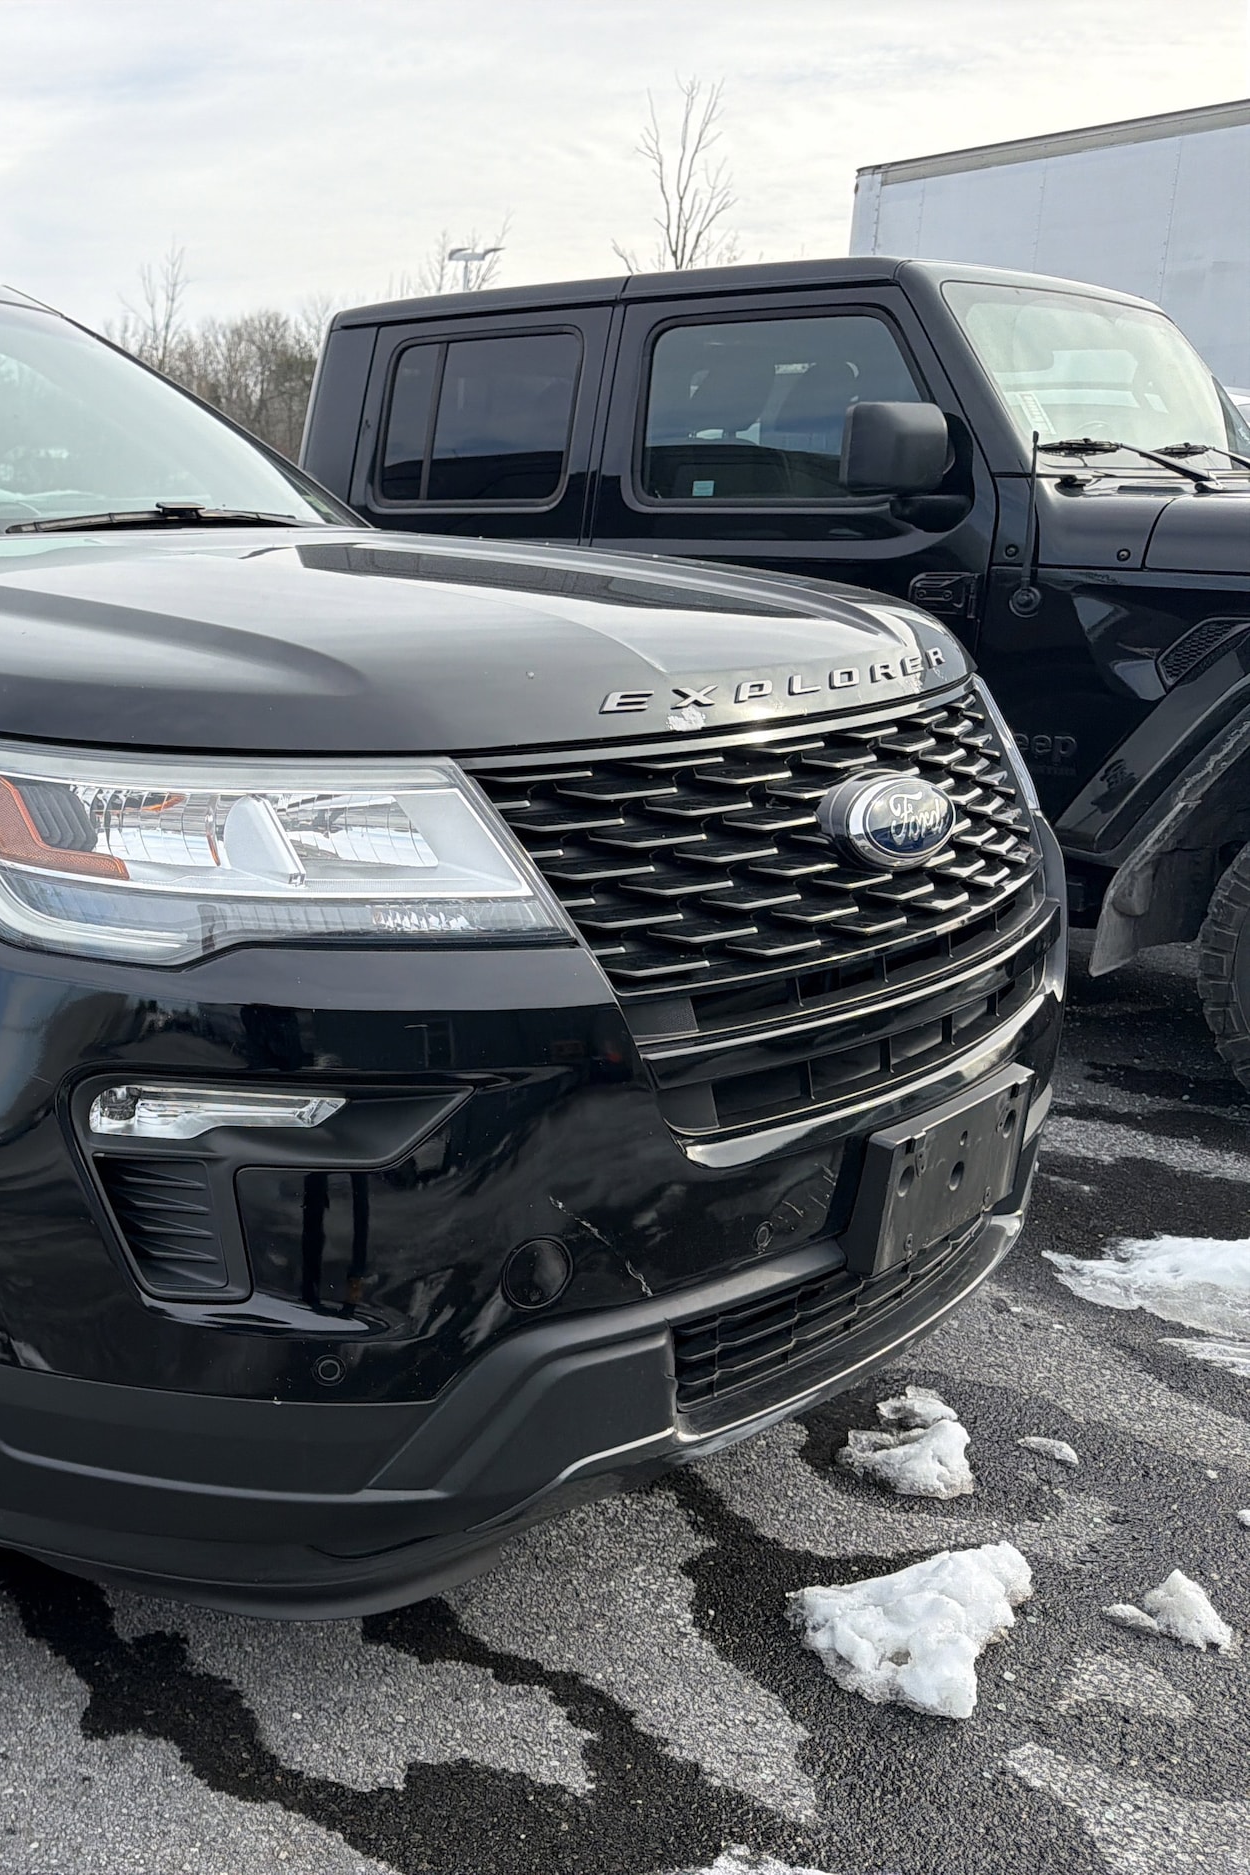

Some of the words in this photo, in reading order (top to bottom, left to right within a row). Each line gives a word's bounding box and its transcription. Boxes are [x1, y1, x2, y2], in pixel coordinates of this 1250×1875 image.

[599, 646, 946, 714] EXPLORER
[1014, 732, 1078, 763] eep
[889, 791, 945, 846] Ford
